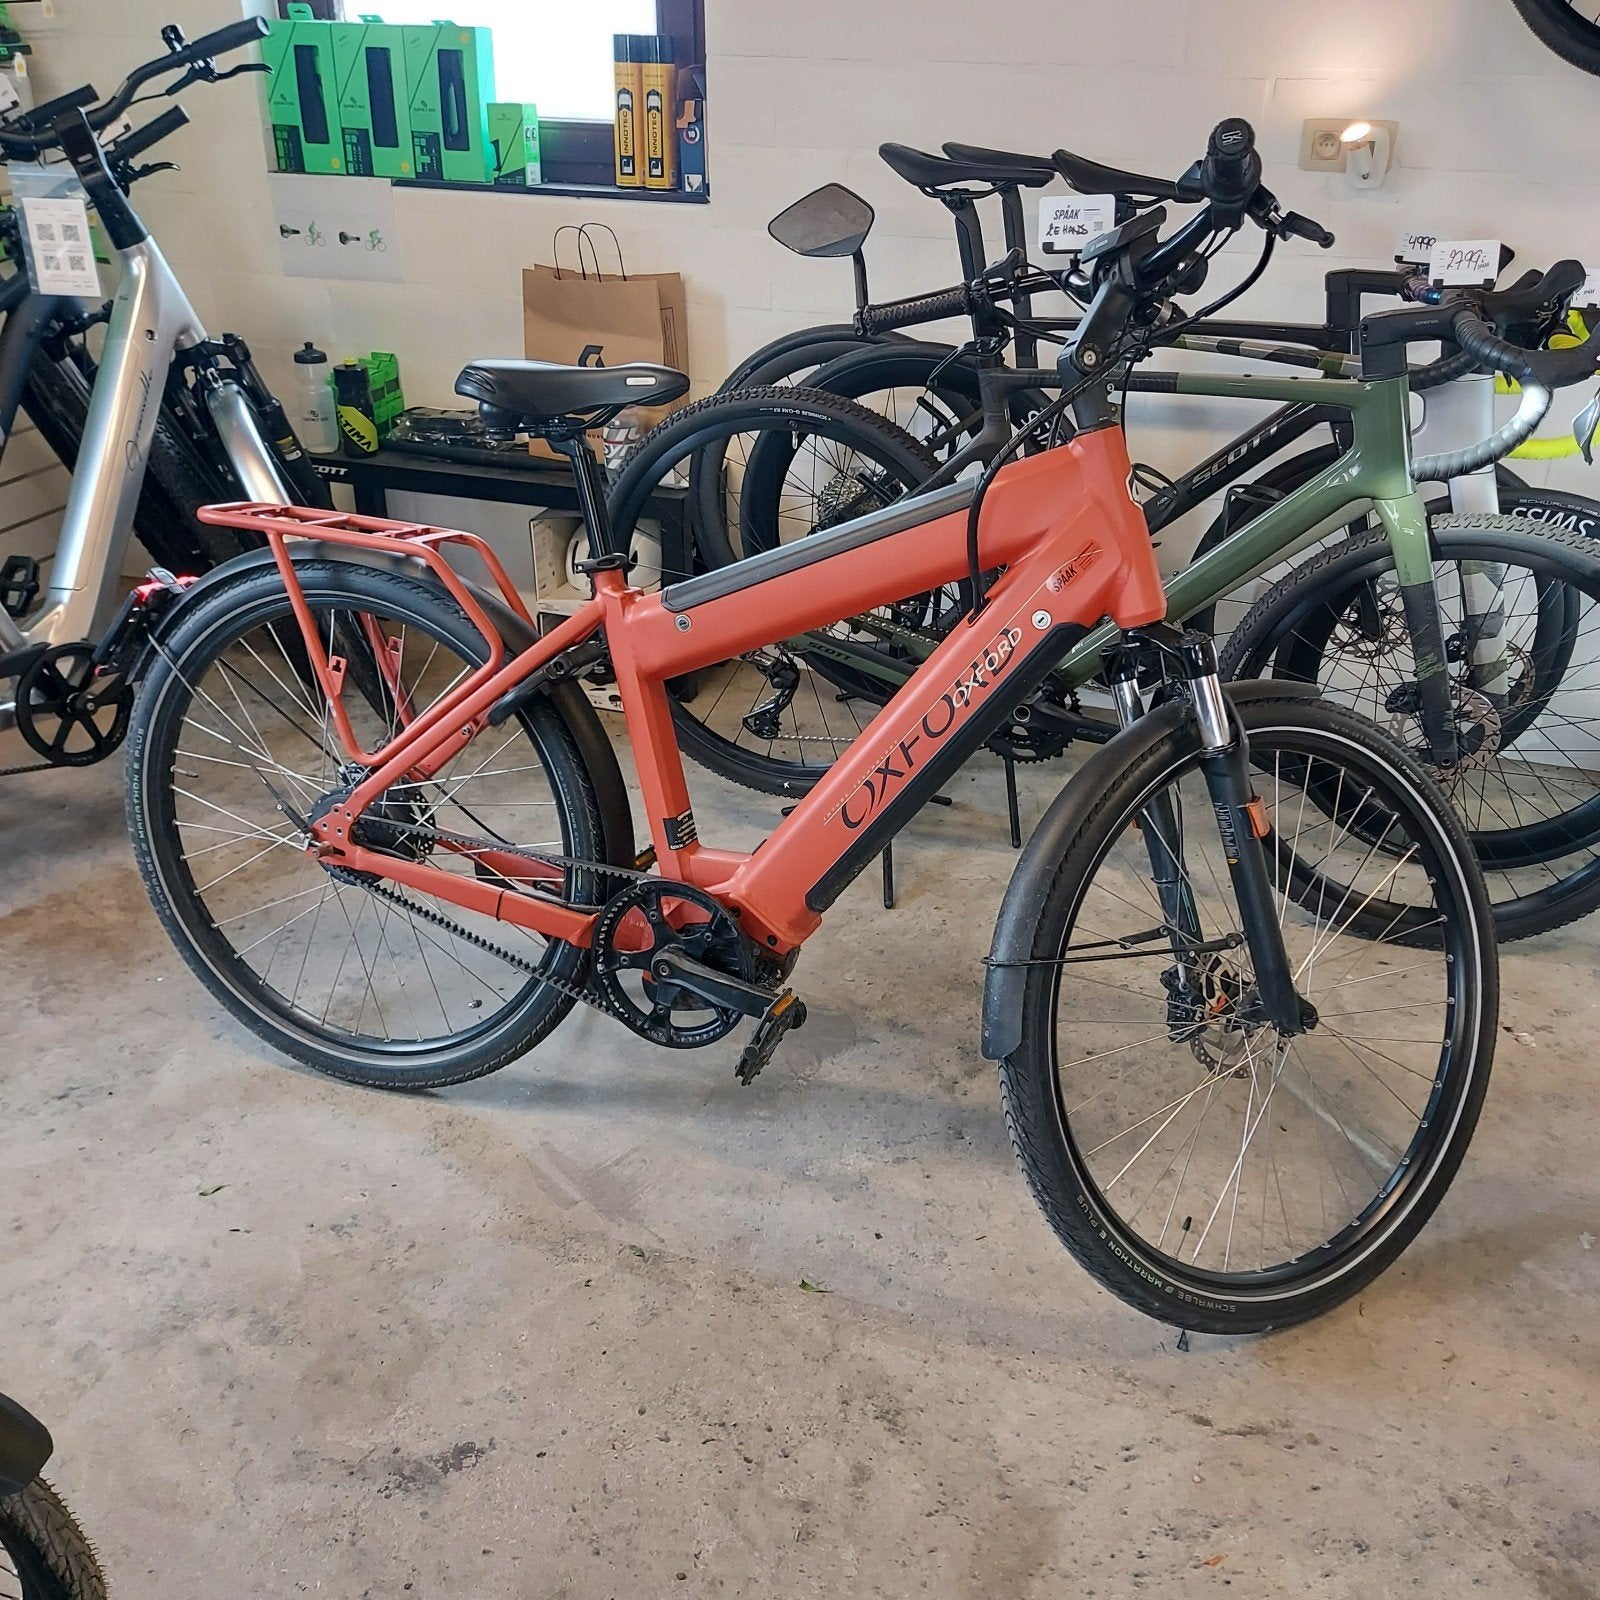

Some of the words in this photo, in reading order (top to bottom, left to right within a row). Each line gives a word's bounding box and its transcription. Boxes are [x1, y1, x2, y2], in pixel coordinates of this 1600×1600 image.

[1191, 419, 1282, 490] SCOTT
[808, 641, 852, 660] SCOTT
[952, 627, 1022, 708] OXFORD
[134, 728, 145, 758] PLUS
[133, 774, 146, 839] MARATHON
[1076, 1194, 1099, 1228] PLUS
[1099, 1230, 1107, 1239] E
[1107, 1241, 1163, 1288] MARATHON
[1178, 1292, 1237, 1313] SCHWALBE
